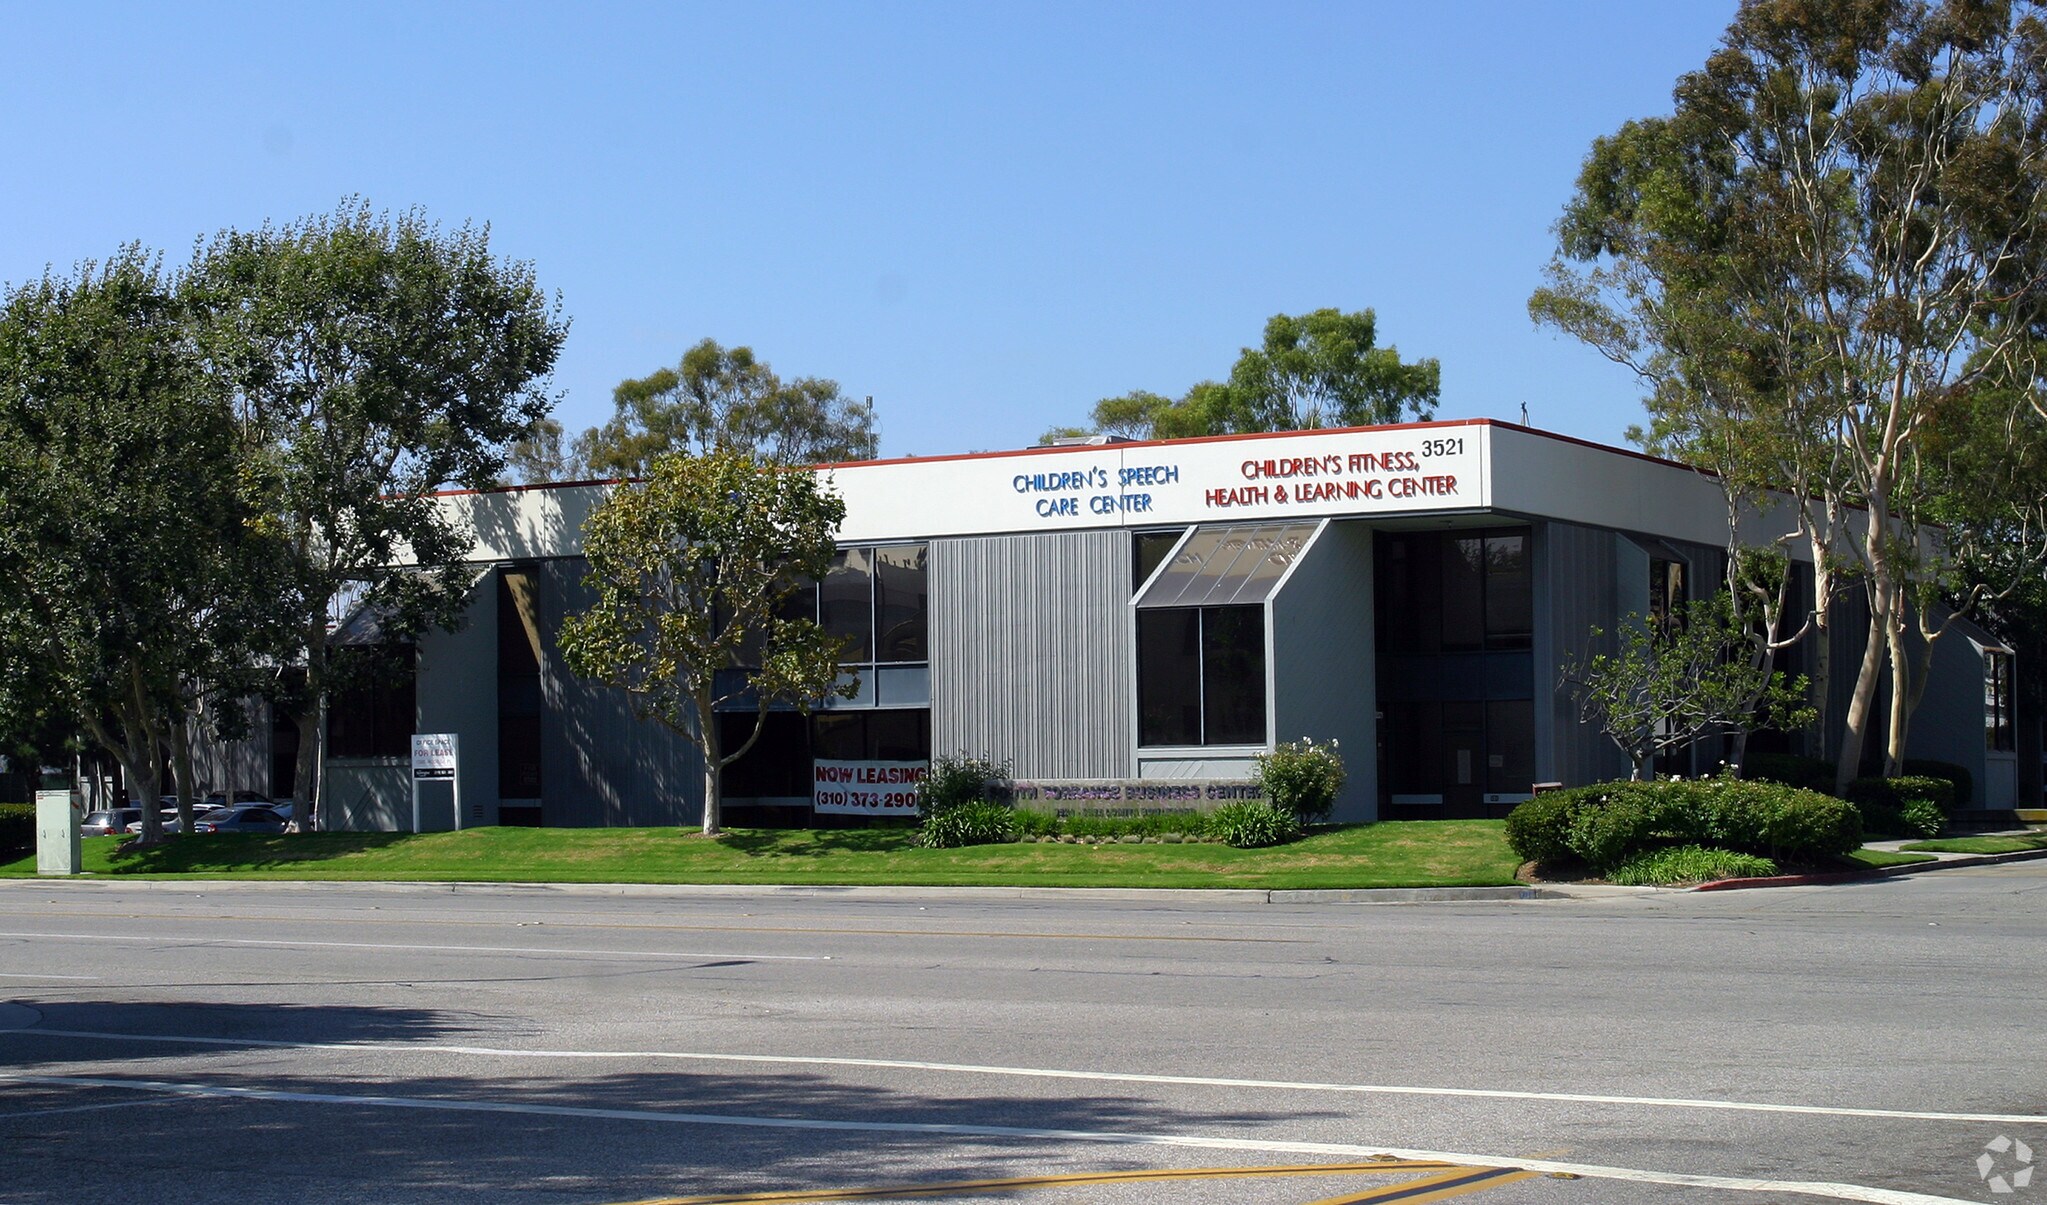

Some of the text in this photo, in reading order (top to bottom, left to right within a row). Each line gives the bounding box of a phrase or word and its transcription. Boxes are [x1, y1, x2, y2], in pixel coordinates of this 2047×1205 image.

[1421, 438, 1464, 458] 3521
[1241, 451, 1421, 480] CHILDREN'S FITNESS,
[1012, 464, 1179, 493] CHILDREN'S SPEECH
[1205, 475, 1459, 508] HEALTH & LEARNING CENTER
[1035, 493, 1153, 518] CARE CENTER
[815, 766, 927, 784] NOW LEASING
[816, 790, 920, 808] (310) 373-290
[1125, 785, 1200, 800] BUSINESS
[1205, 785, 1263, 800] CENTER
